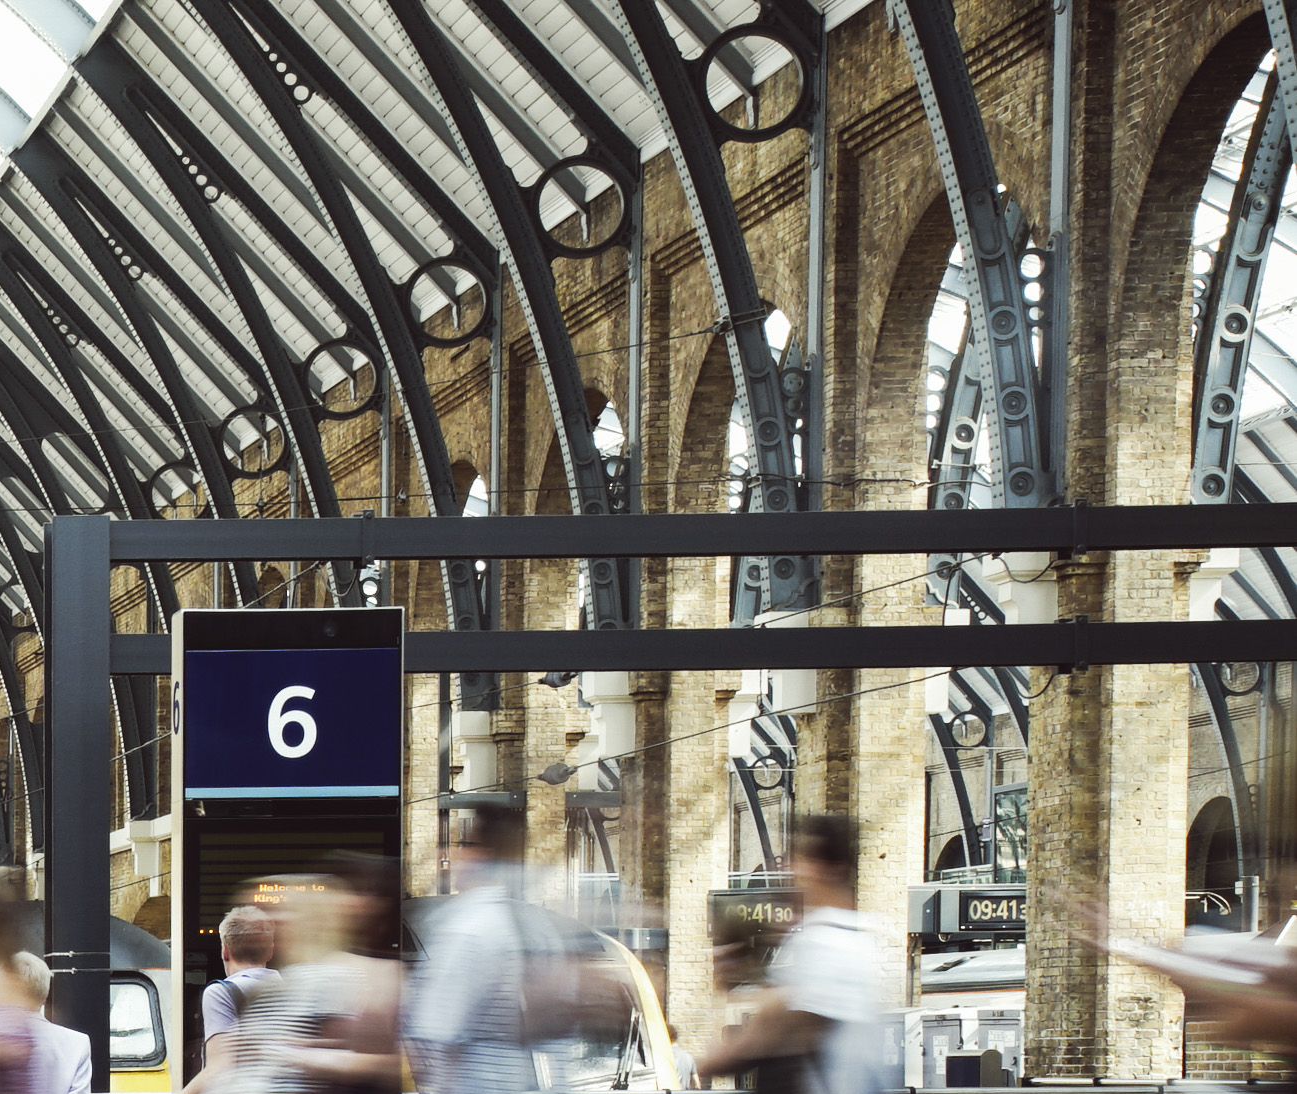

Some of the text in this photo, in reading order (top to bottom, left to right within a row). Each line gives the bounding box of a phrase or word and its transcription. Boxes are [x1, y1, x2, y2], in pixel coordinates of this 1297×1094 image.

[172, 680, 180, 735] 6
[267, 685, 318, 759] 6
[258, 883, 325, 893] Welcoe to
[969, 899, 1017, 921] 09:41
